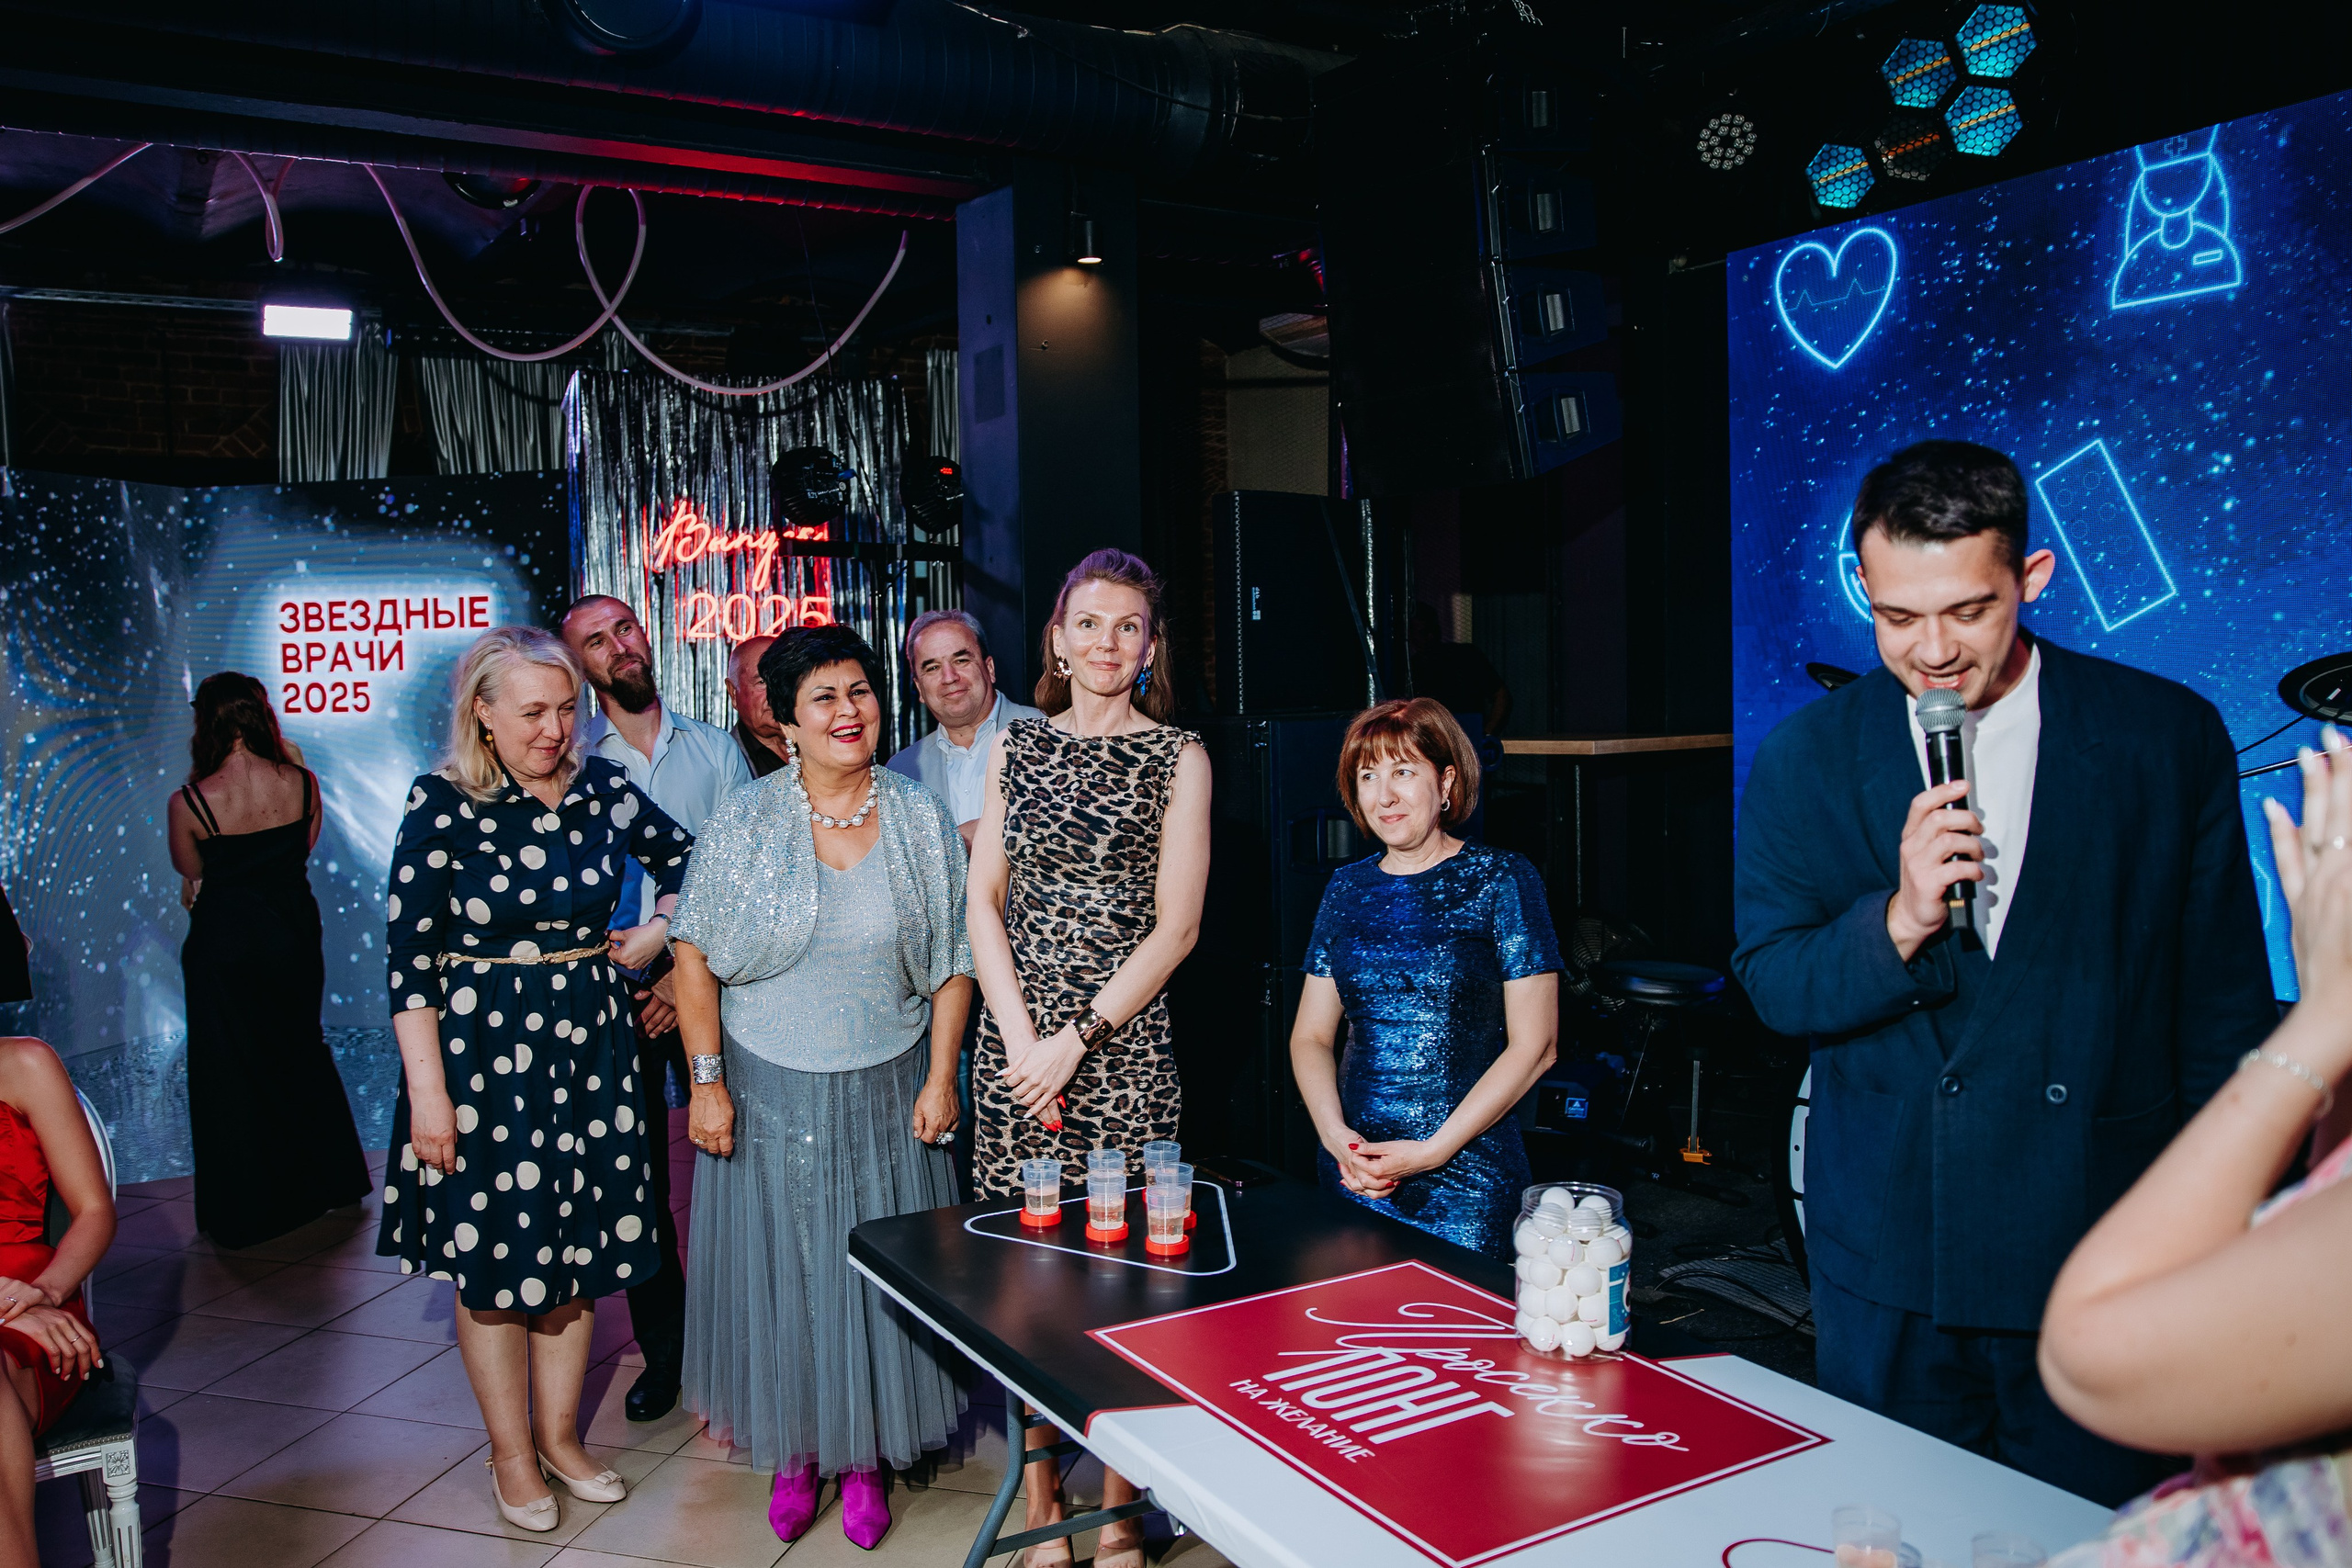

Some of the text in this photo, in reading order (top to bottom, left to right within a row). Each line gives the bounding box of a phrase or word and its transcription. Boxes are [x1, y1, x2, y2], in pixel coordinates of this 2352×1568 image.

[279, 596, 490, 637] ЗВЕЗДНЫЕ
[688, 592, 829, 641] 2025
[281, 640, 404, 673] ВРАЧИ
[283, 682, 370, 714] 2025
[1262, 1347, 1515, 1445] ПОНГ
[1229, 1379, 1376, 1463] НА ЖЕЛАНИЕ
